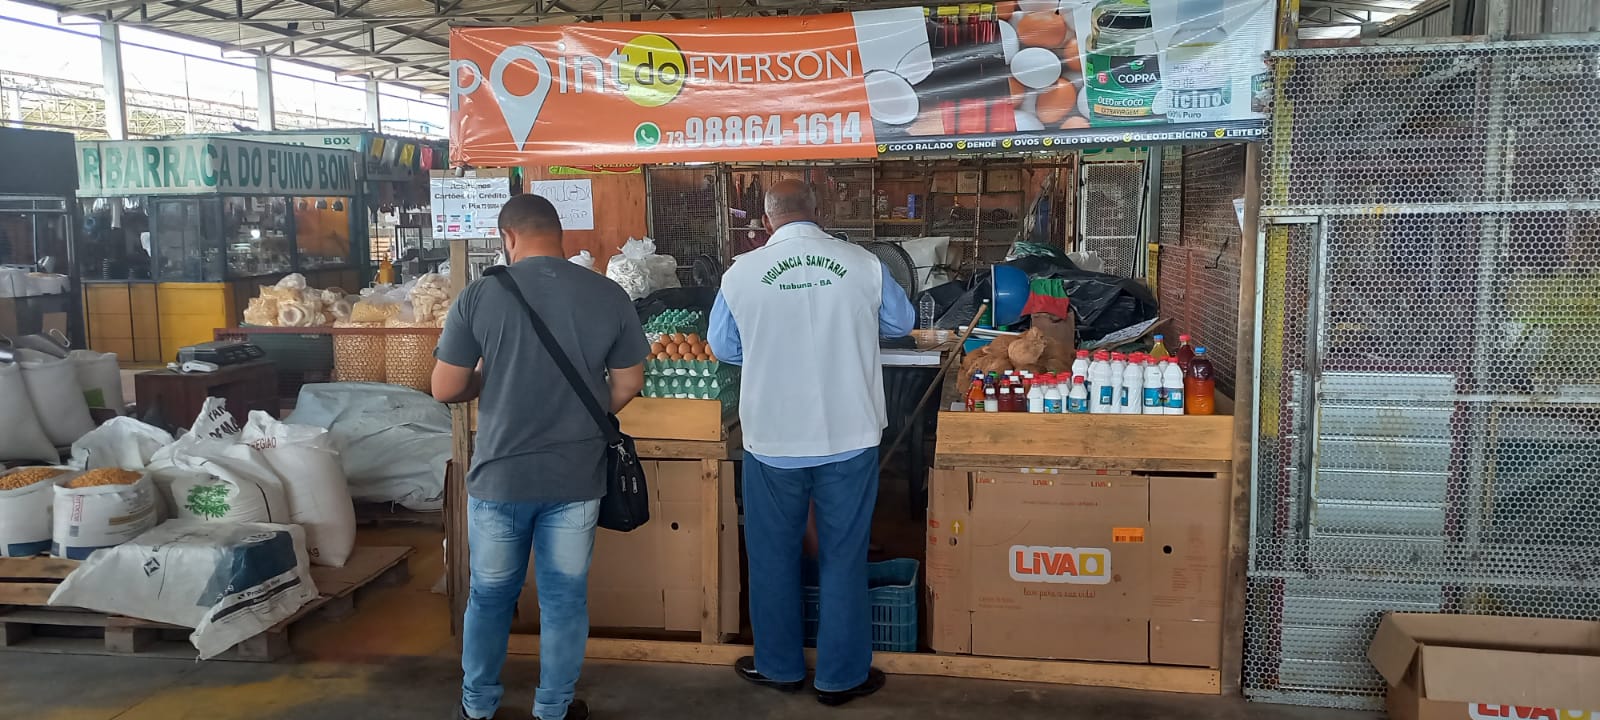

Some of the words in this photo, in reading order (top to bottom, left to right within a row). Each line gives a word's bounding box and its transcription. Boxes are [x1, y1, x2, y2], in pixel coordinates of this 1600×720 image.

[635, 52, 679, 86] do
[688, 50, 853, 83] EMERSON
[1118, 73, 1158, 83] COPRA
[324, 137, 350, 145] BOX
[666, 131, 685, 147] 73
[686, 111, 861, 147] 98864-1614
[915, 142, 953, 150] RALADO
[967, 141, 996, 149] DENDÊ
[1014, 138, 1039, 146] OVOS
[1054, 136, 1079, 145] ÓLEO
[1094, 135, 1119, 143] COCO
[1134, 132, 1159, 141] ÓLEO
[1161, 132, 1175, 140] DE
[1176, 130, 1208, 139] RÍCINO
[1226, 129, 1254, 137] LEITE
[105, 143, 232, 188] BARRACA
[238, 147, 262, 188] DO
[268, 150, 313, 190] FUMO
[318, 153, 349, 191] BOM
[761, 256, 802, 285] VIGILÂNCIA
[806, 255, 847, 279] SANITÁRIA
[779, 281, 812, 290] Itabuna
[1016, 551, 1078, 576] LiVA
